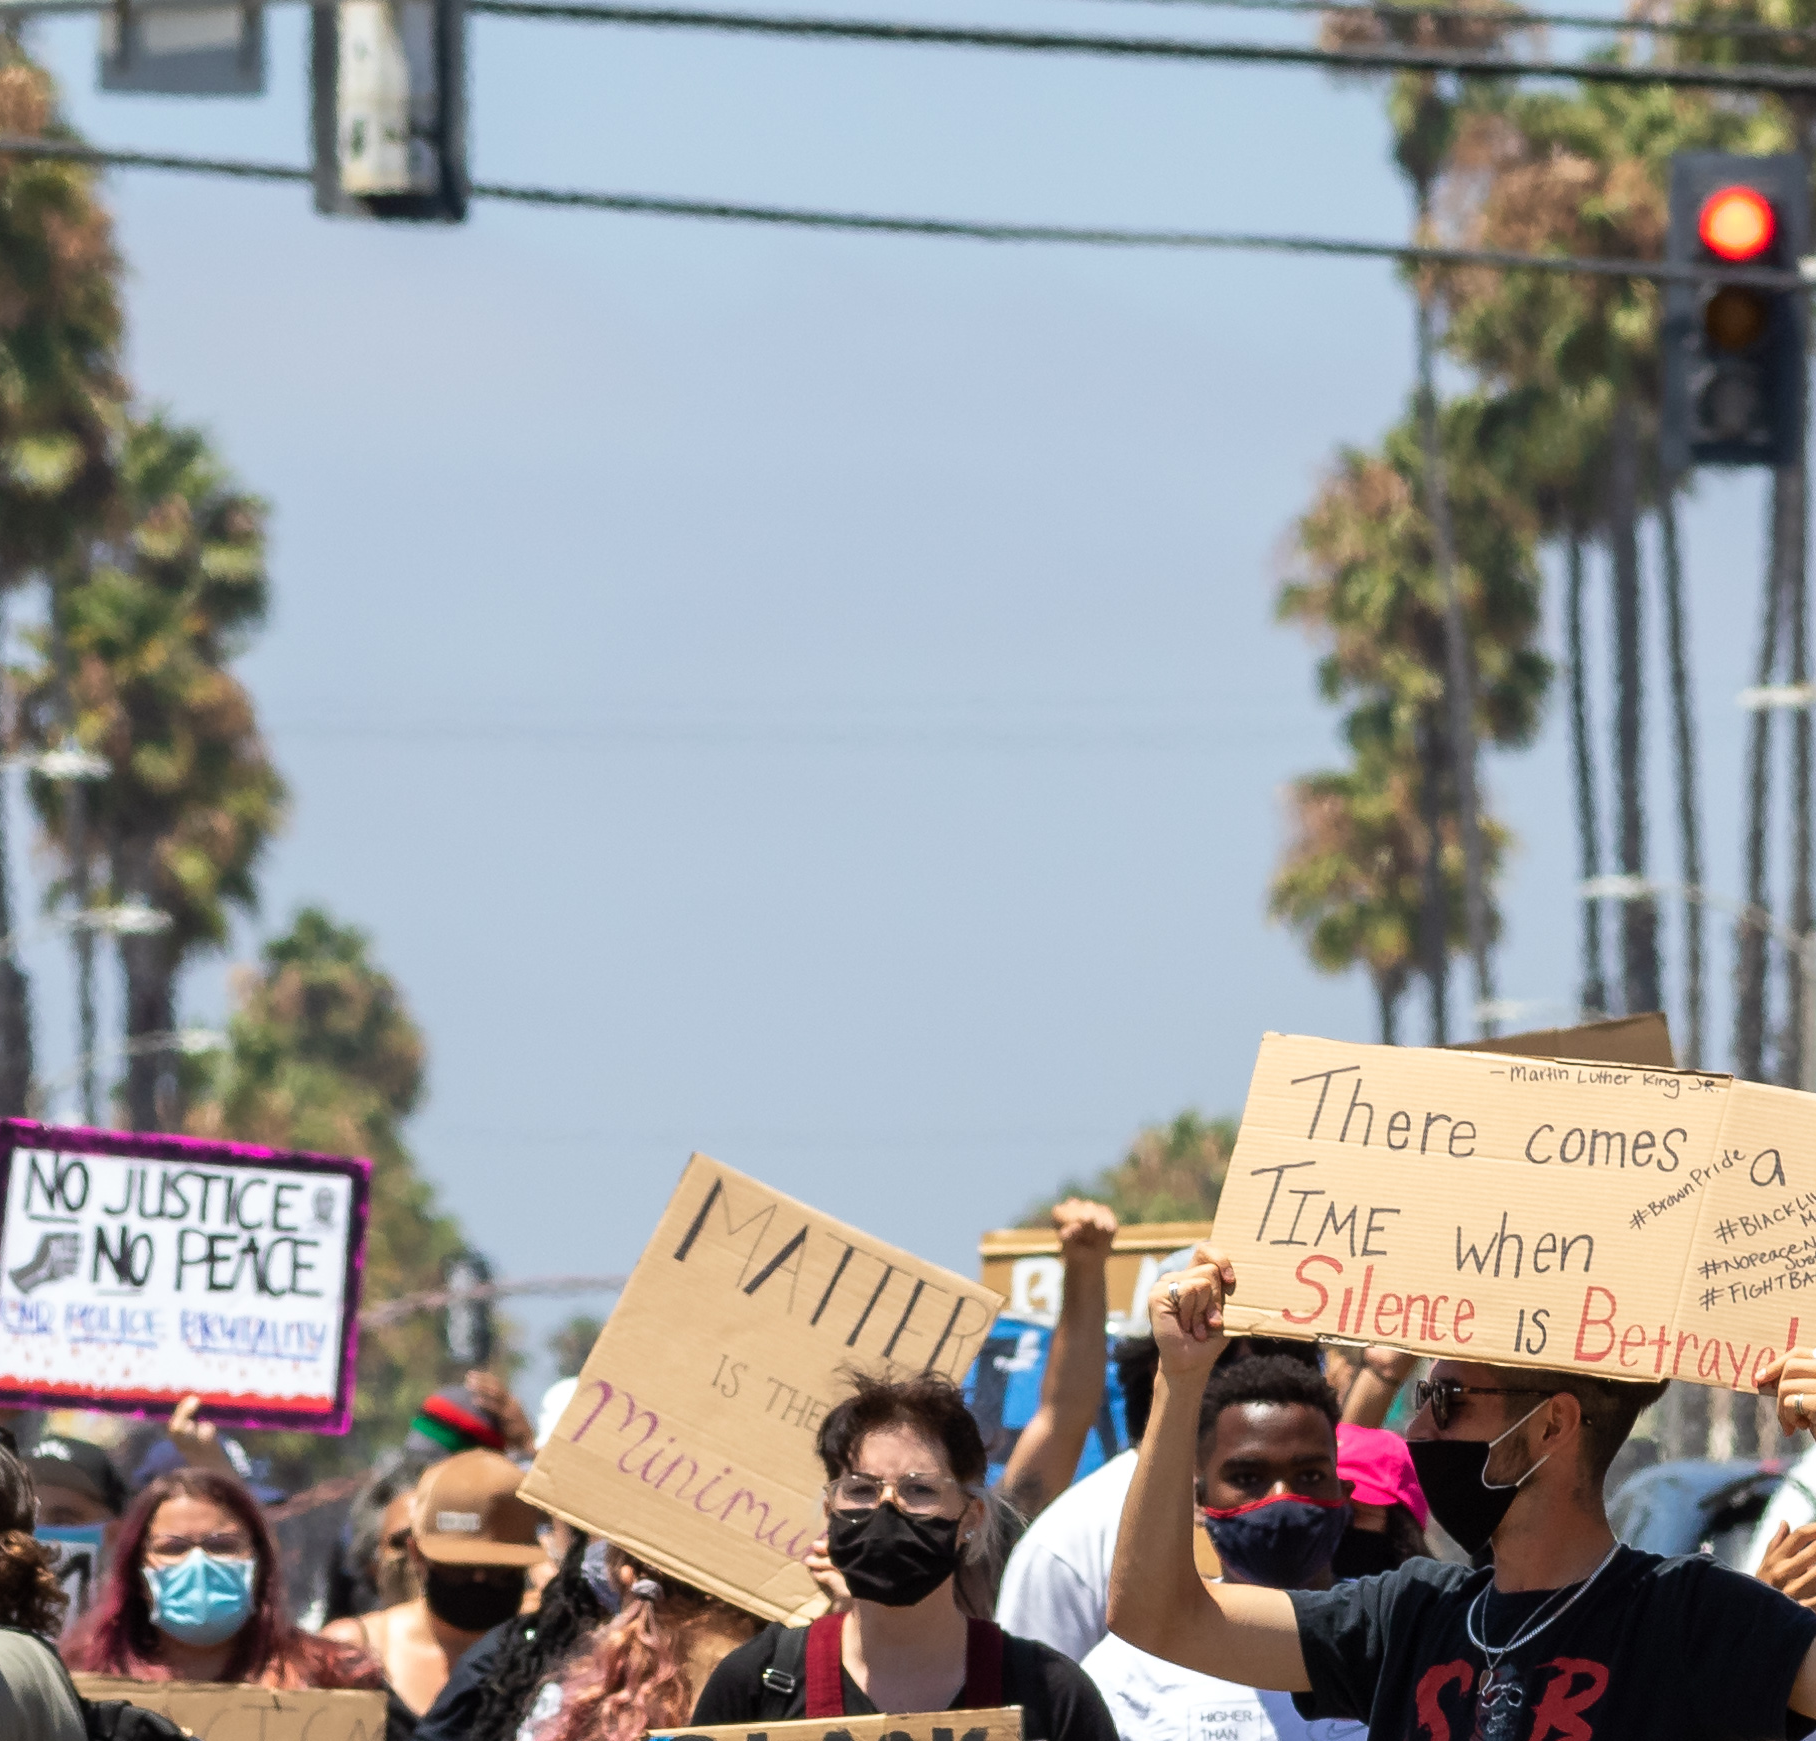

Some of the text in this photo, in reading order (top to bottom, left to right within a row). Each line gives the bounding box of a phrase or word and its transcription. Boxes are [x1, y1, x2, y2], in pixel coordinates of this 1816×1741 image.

[1290, 1064, 1787, 1188] There comes a
[1577, 1069, 1637, 1089] Luther
[1641, 1072, 1682, 1100] King
[23, 1154, 305, 1233] NO JUSTICE
[1249, 1159, 1596, 1280] TIME when
[91, 1225, 324, 1298] NO PEACE
[673, 1176, 991, 1381] MATTER
[1281, 1254, 1477, 1345] Silence
[710, 1352, 833, 1435] IS THE
[1199, 1709, 1254, 1724] HIGHER
